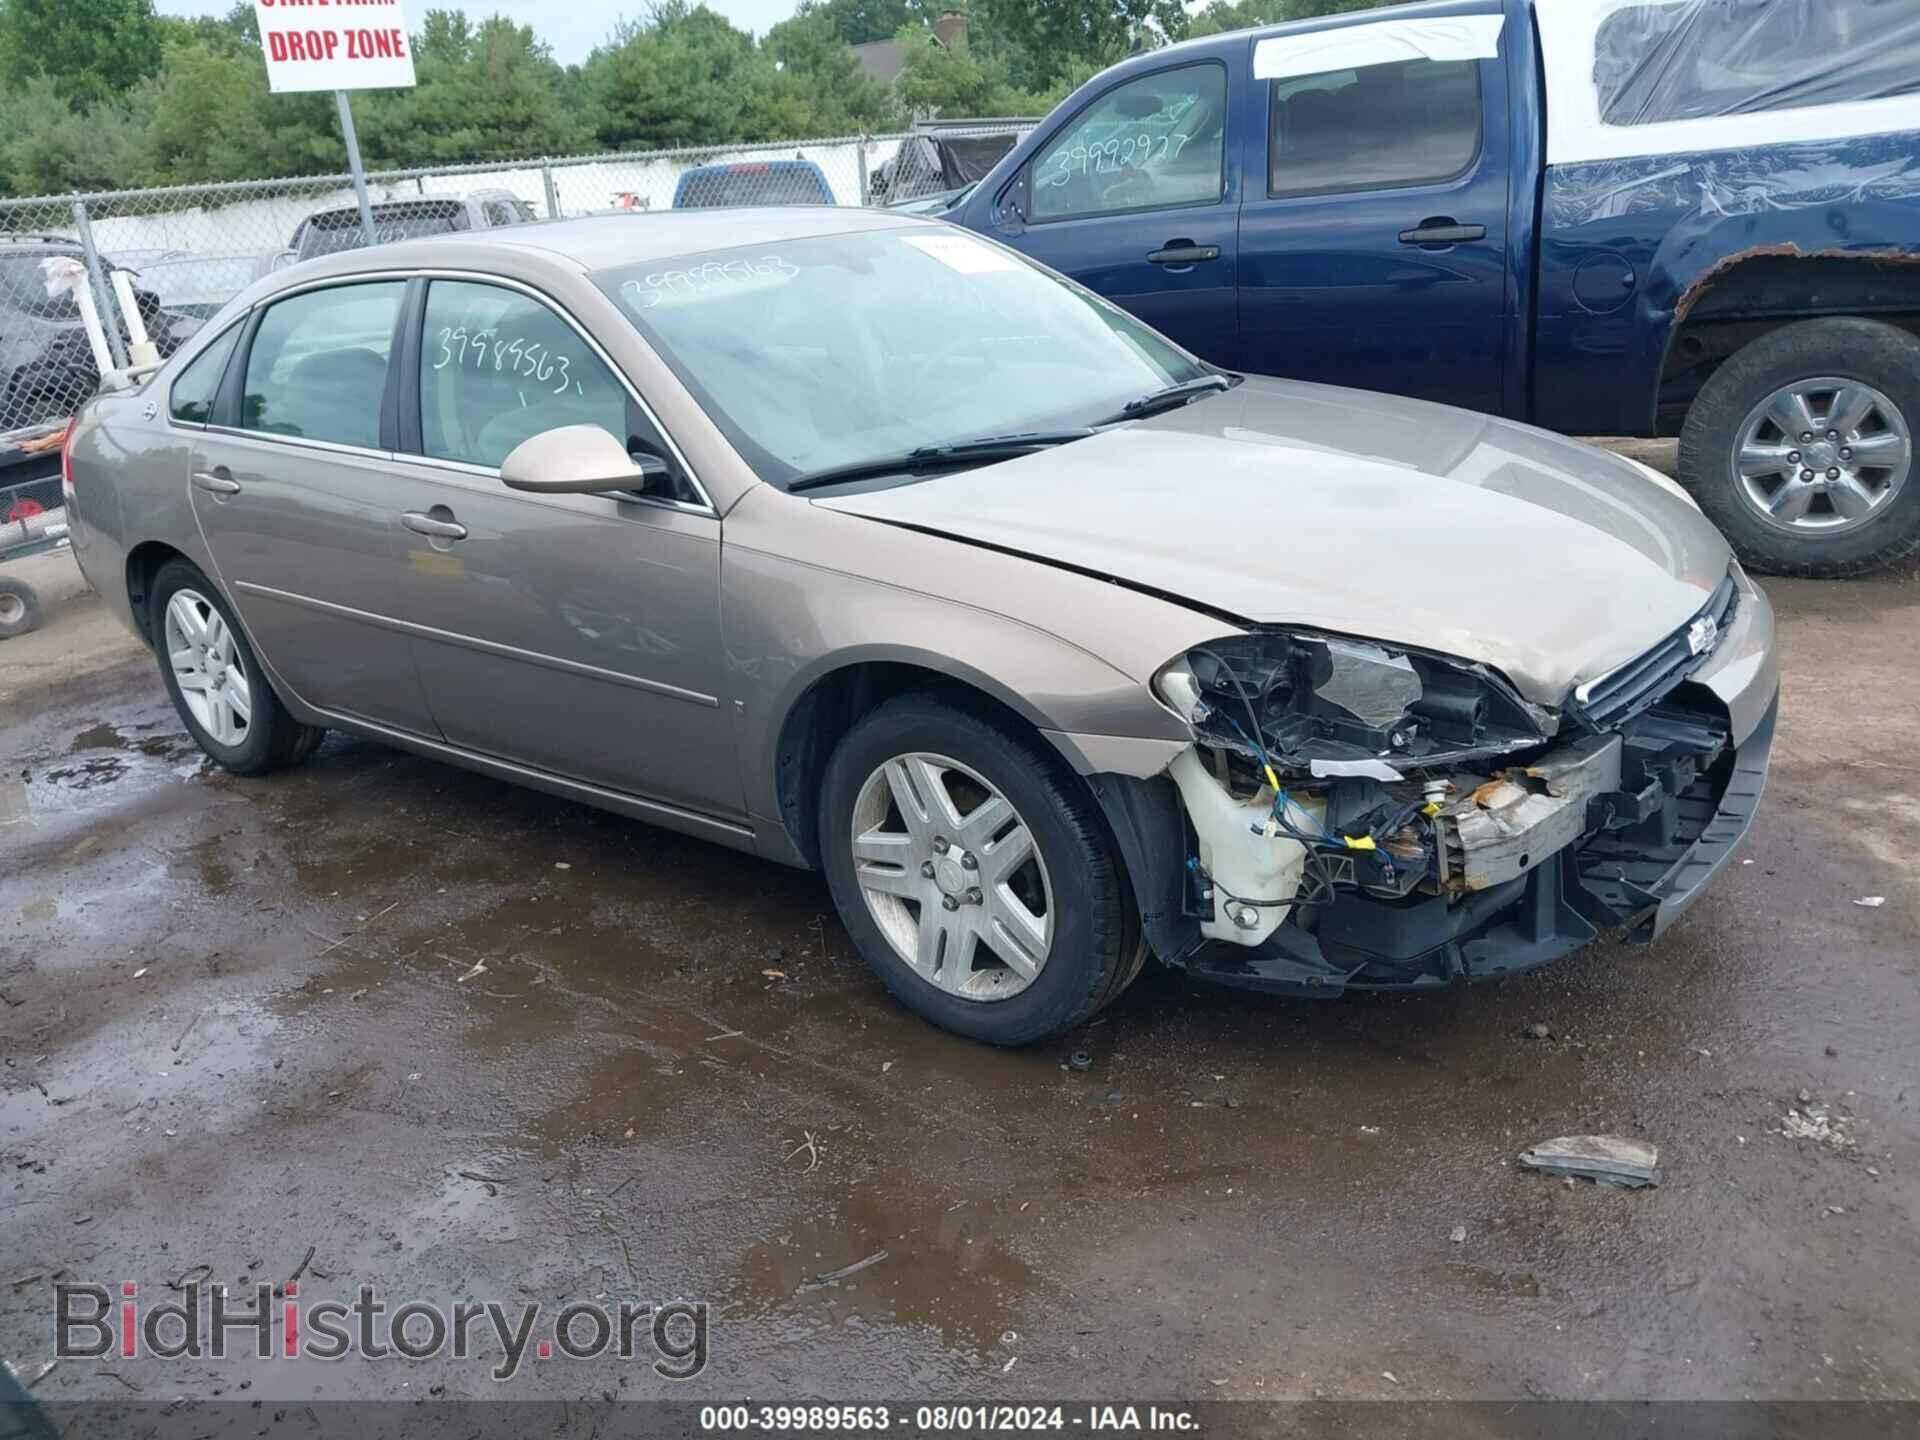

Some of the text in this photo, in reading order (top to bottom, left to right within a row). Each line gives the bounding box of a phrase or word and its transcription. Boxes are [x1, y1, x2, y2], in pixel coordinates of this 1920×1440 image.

[268, 28, 405, 62] DROP ZONE
[1050, 134, 1188, 187] 39992927
